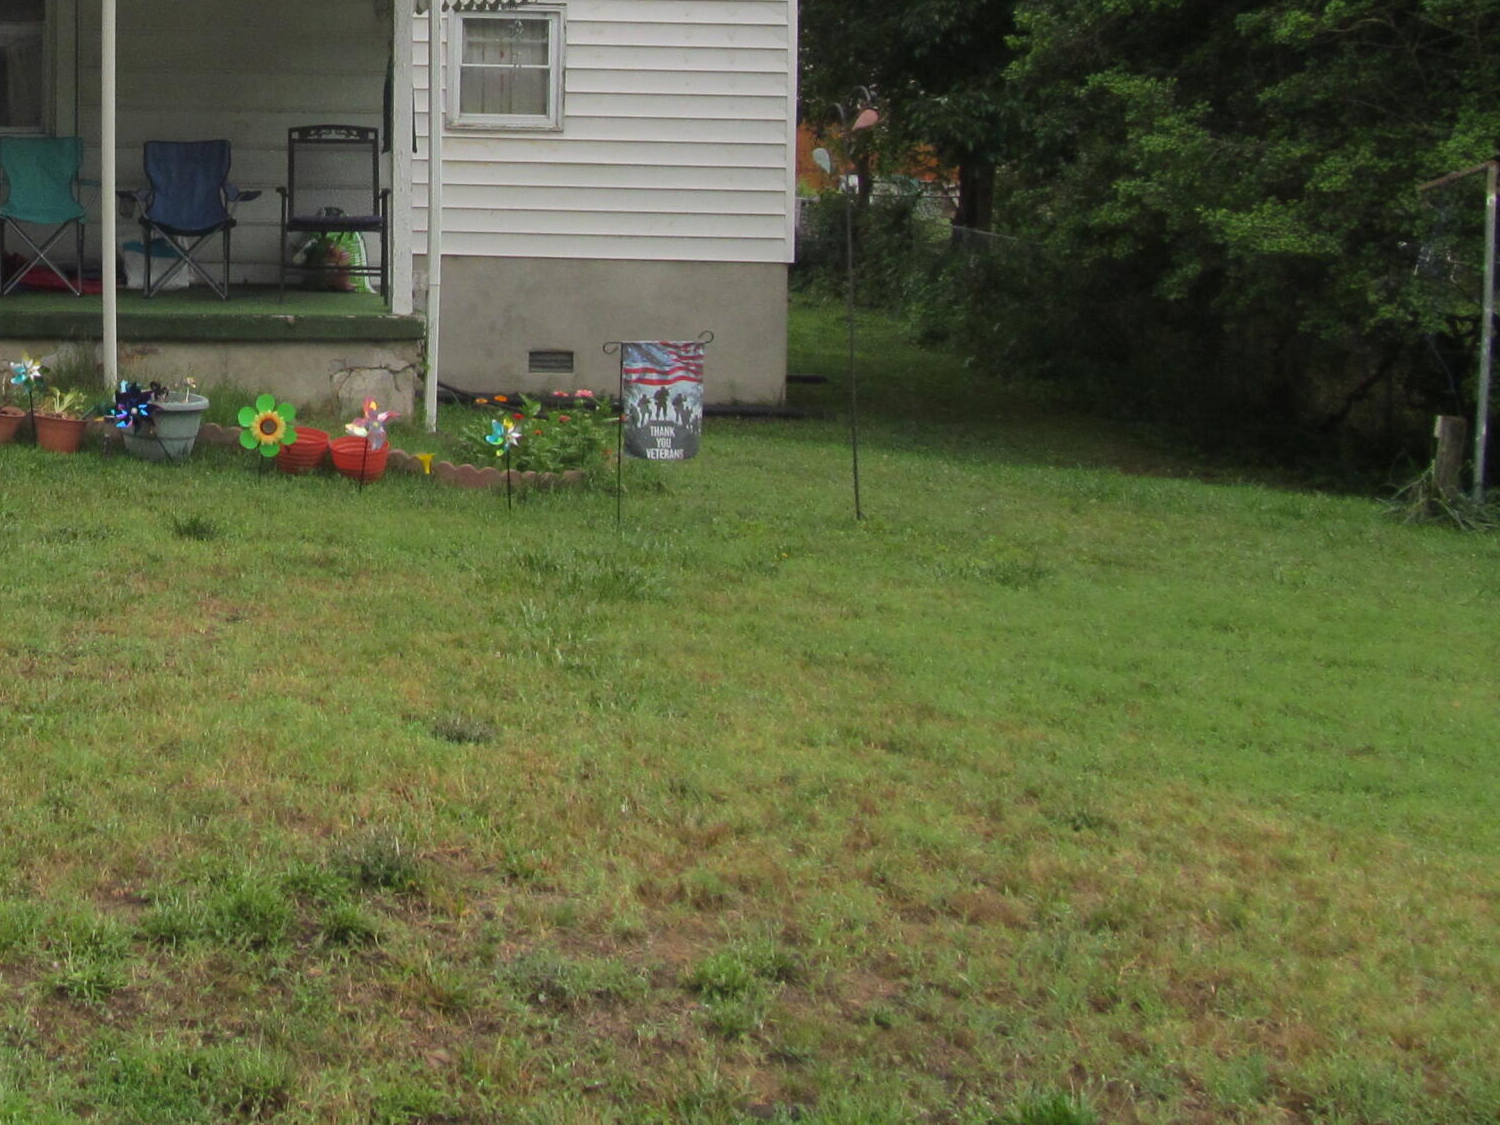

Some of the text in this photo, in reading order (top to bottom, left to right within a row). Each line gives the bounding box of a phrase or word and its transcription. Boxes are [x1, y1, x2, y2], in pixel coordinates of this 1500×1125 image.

[650, 426, 675, 437] THANK
[656, 437, 672, 448] YOU
[646, 448, 684, 459] VETERANS
